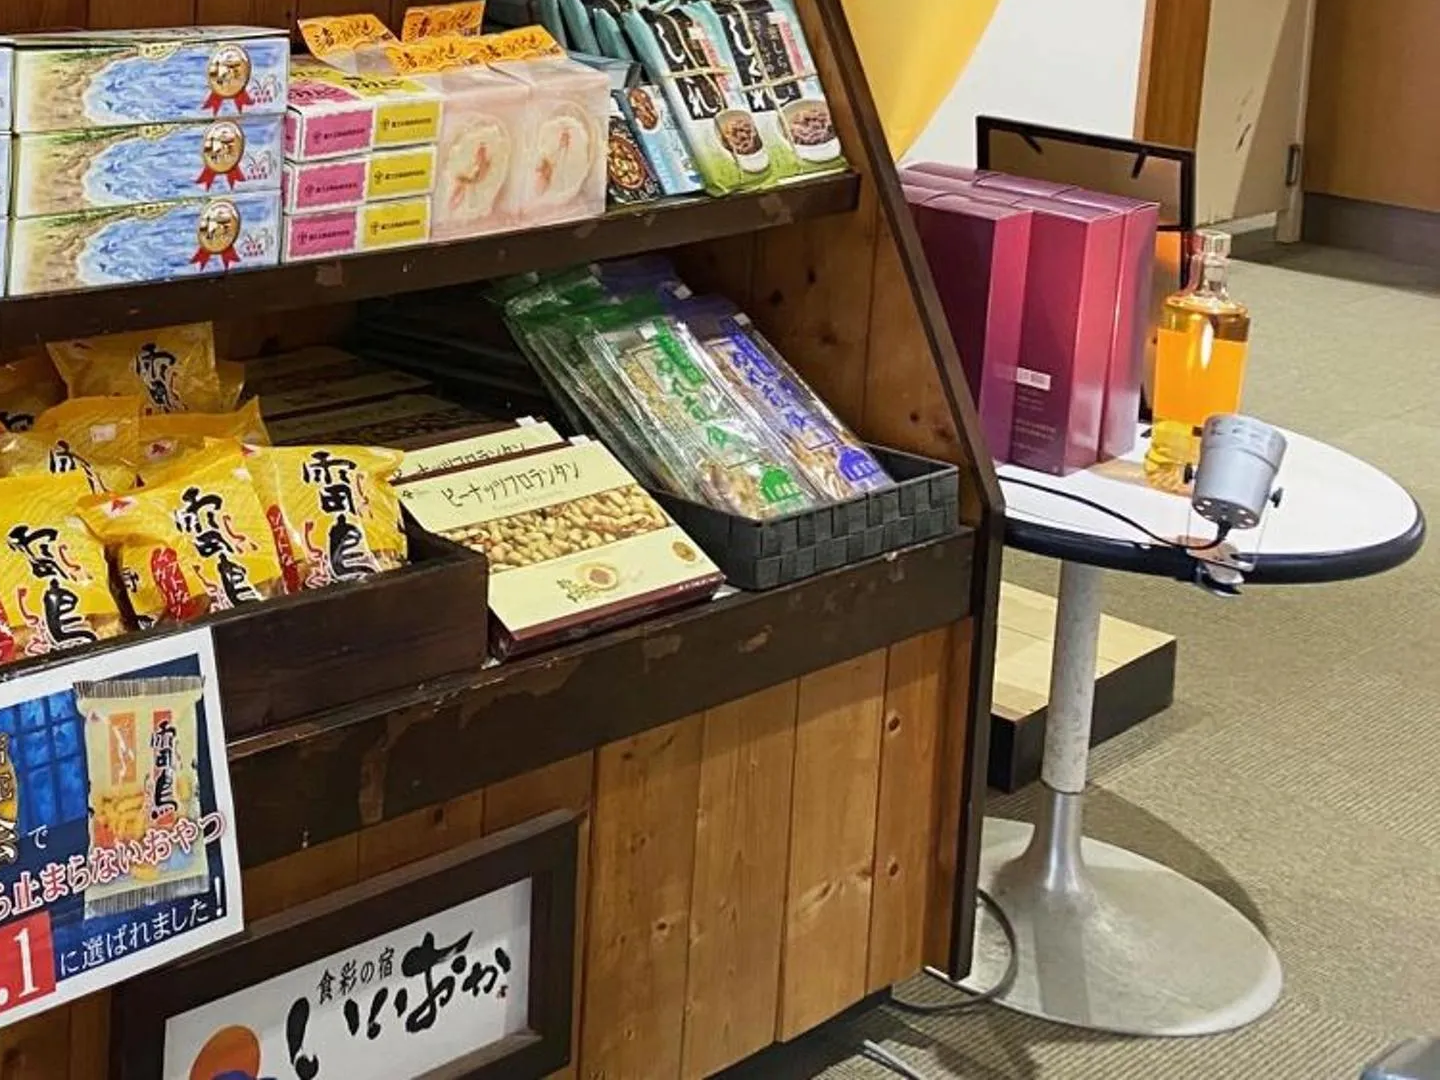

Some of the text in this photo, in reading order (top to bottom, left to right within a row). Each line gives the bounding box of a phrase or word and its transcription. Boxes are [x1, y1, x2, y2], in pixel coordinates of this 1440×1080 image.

[441, 460, 580, 510] ピーナッツフロランタン
[285, 930, 513, 1080] いいおか
[316, 946, 395, 1005] 食彩の宿
